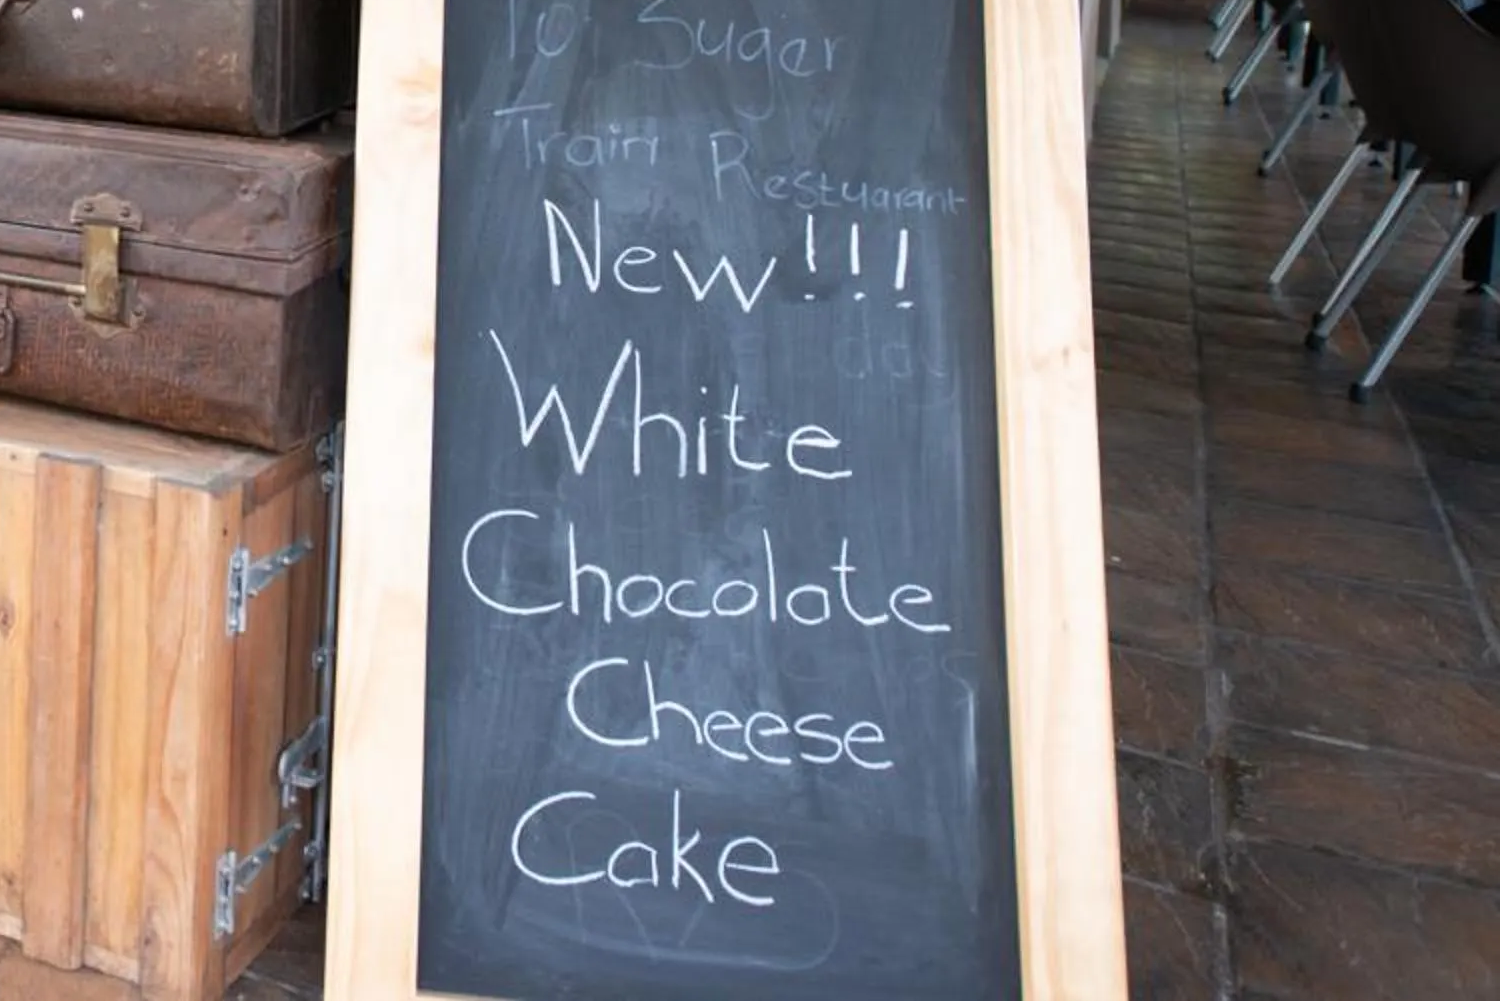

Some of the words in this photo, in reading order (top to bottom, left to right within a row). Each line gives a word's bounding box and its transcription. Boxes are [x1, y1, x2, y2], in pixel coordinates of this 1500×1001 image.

[493, 101, 660, 171] Train
[488, 327, 853, 480] White
[461, 508, 952, 632] Chocolate
[565, 656, 894, 769] Cheese
[511, 789, 780, 906] Cake
